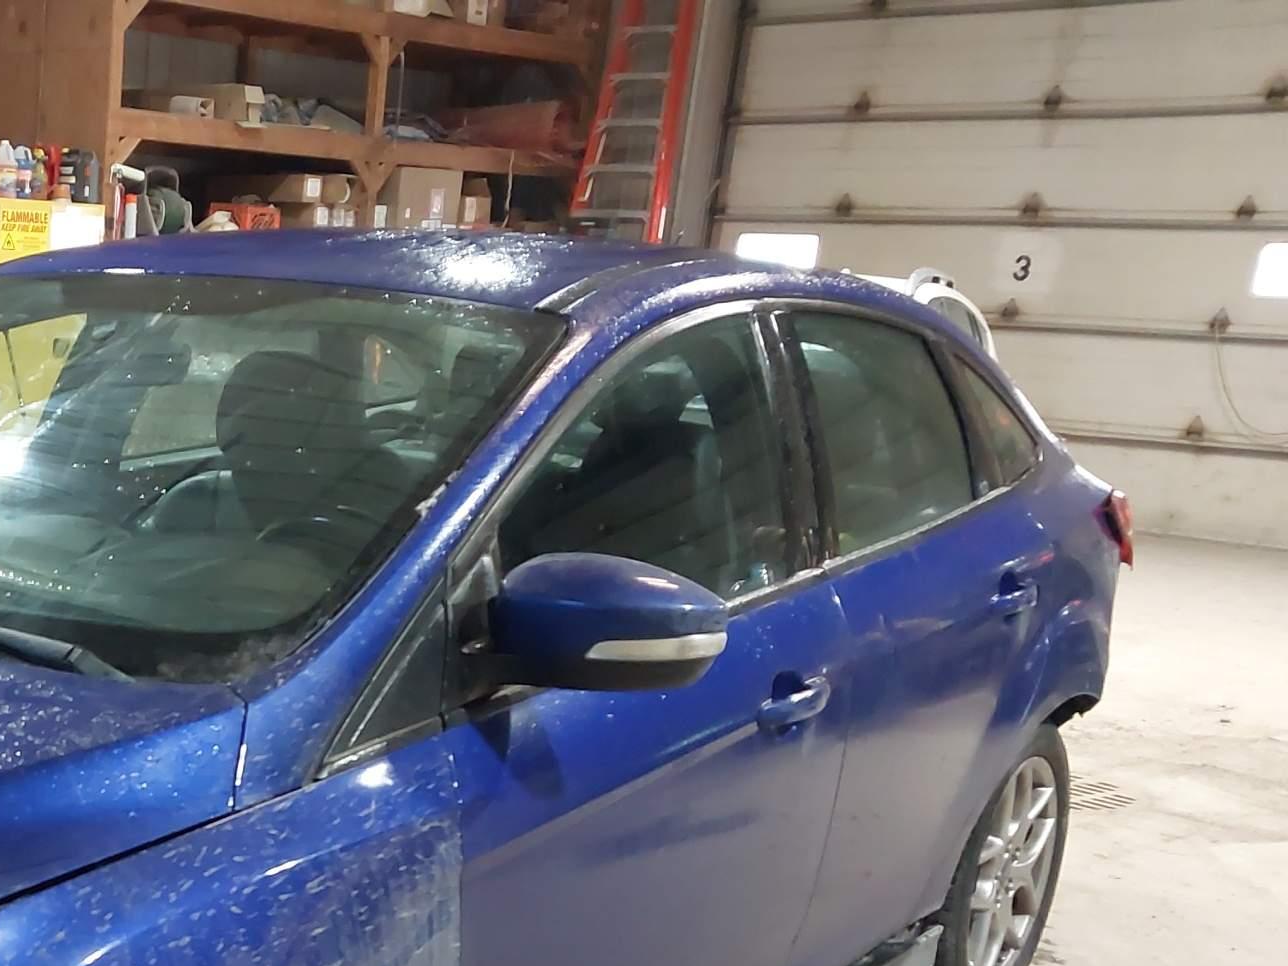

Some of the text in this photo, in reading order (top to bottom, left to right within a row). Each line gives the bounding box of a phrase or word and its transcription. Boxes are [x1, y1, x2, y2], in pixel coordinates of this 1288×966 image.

[2, 210, 48, 224] FLAMMABLE
[1, 223, 16, 232] KEEP
[1013, 255, 1031, 281] 3
